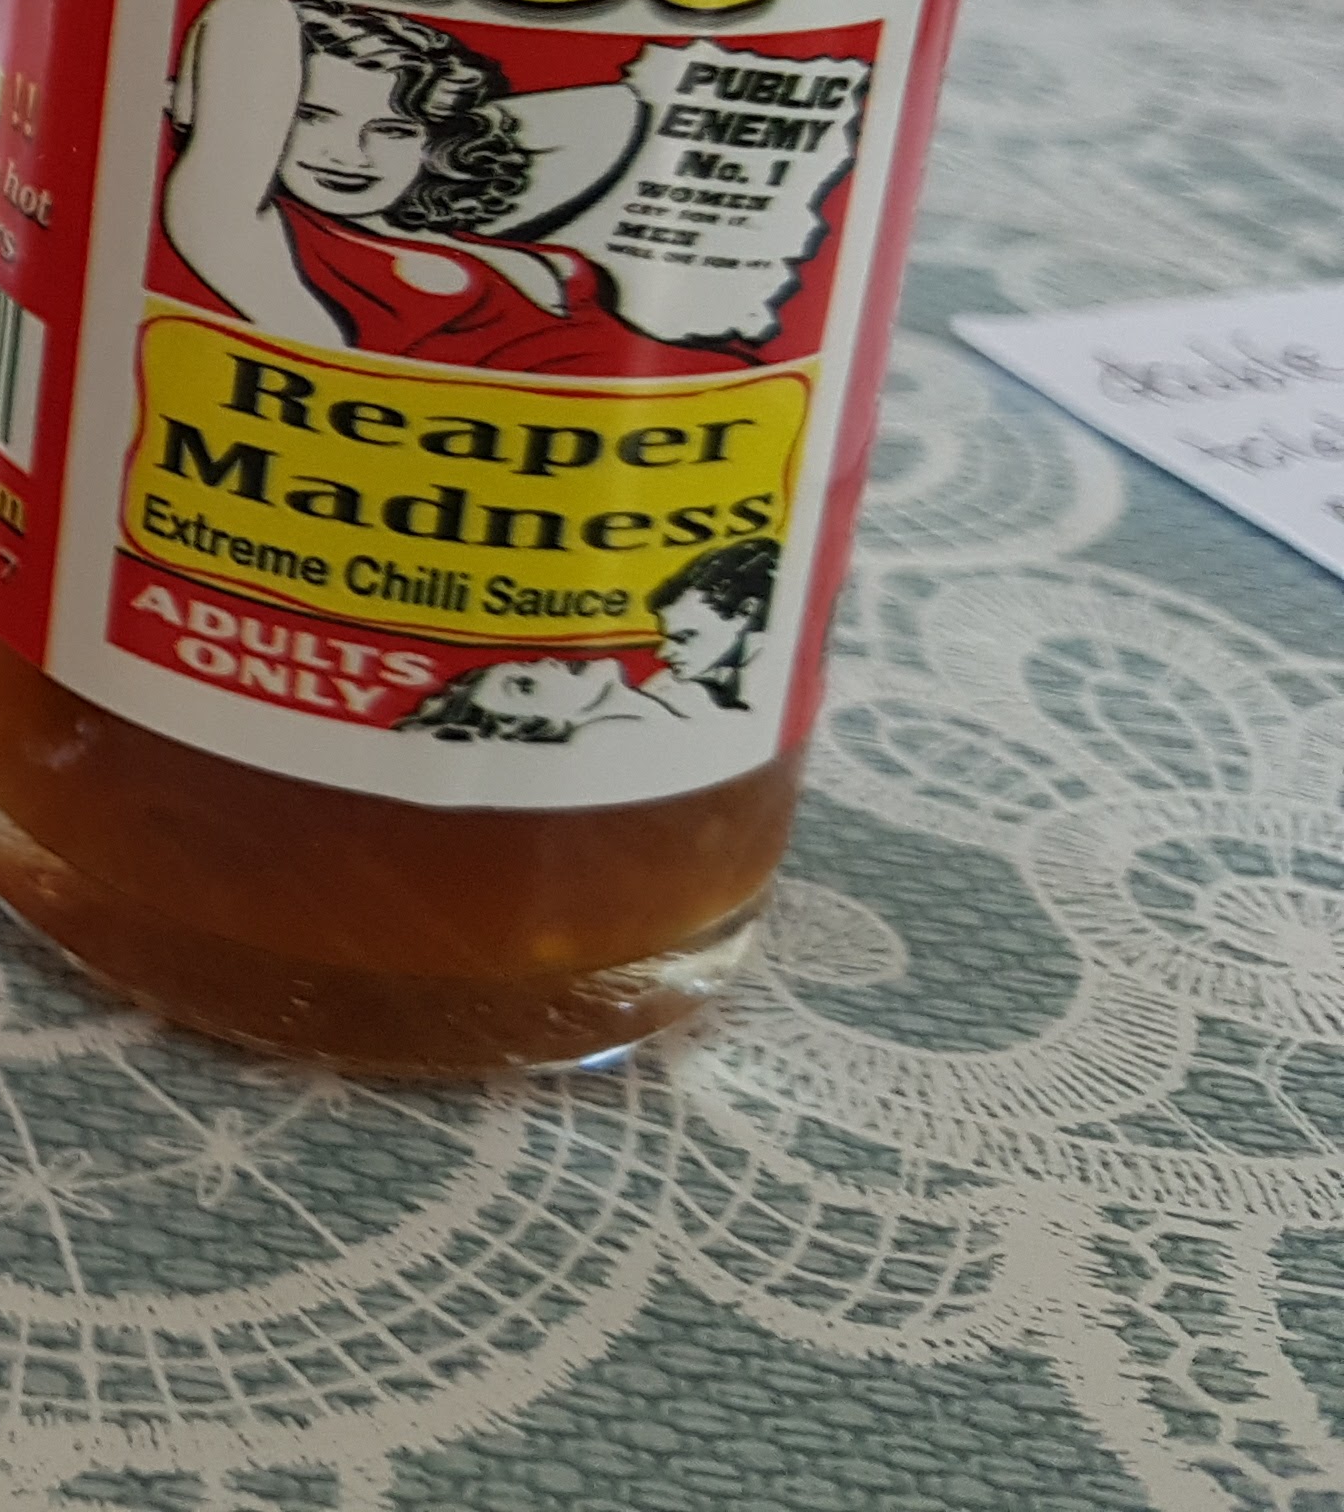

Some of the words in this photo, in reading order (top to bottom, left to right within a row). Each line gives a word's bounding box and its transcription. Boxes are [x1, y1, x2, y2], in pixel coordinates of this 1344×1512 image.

[674, 60, 852, 111] PUBLIC
[656, 101, 836, 154] ENEMY
[3, 158, 54, 228] hot
[635, 179, 775, 212] WOMEN
[674, 149, 750, 185] No.
[216, 351, 758, 478] Reaper
[151, 413, 779, 554] Madness
[138, 492, 331, 588] Extreme
[343, 552, 472, 623] Chilli
[478, 575, 631, 620] Sauce
[127, 581, 441, 689] ADULTS
[170, 632, 395, 717] ONLY
